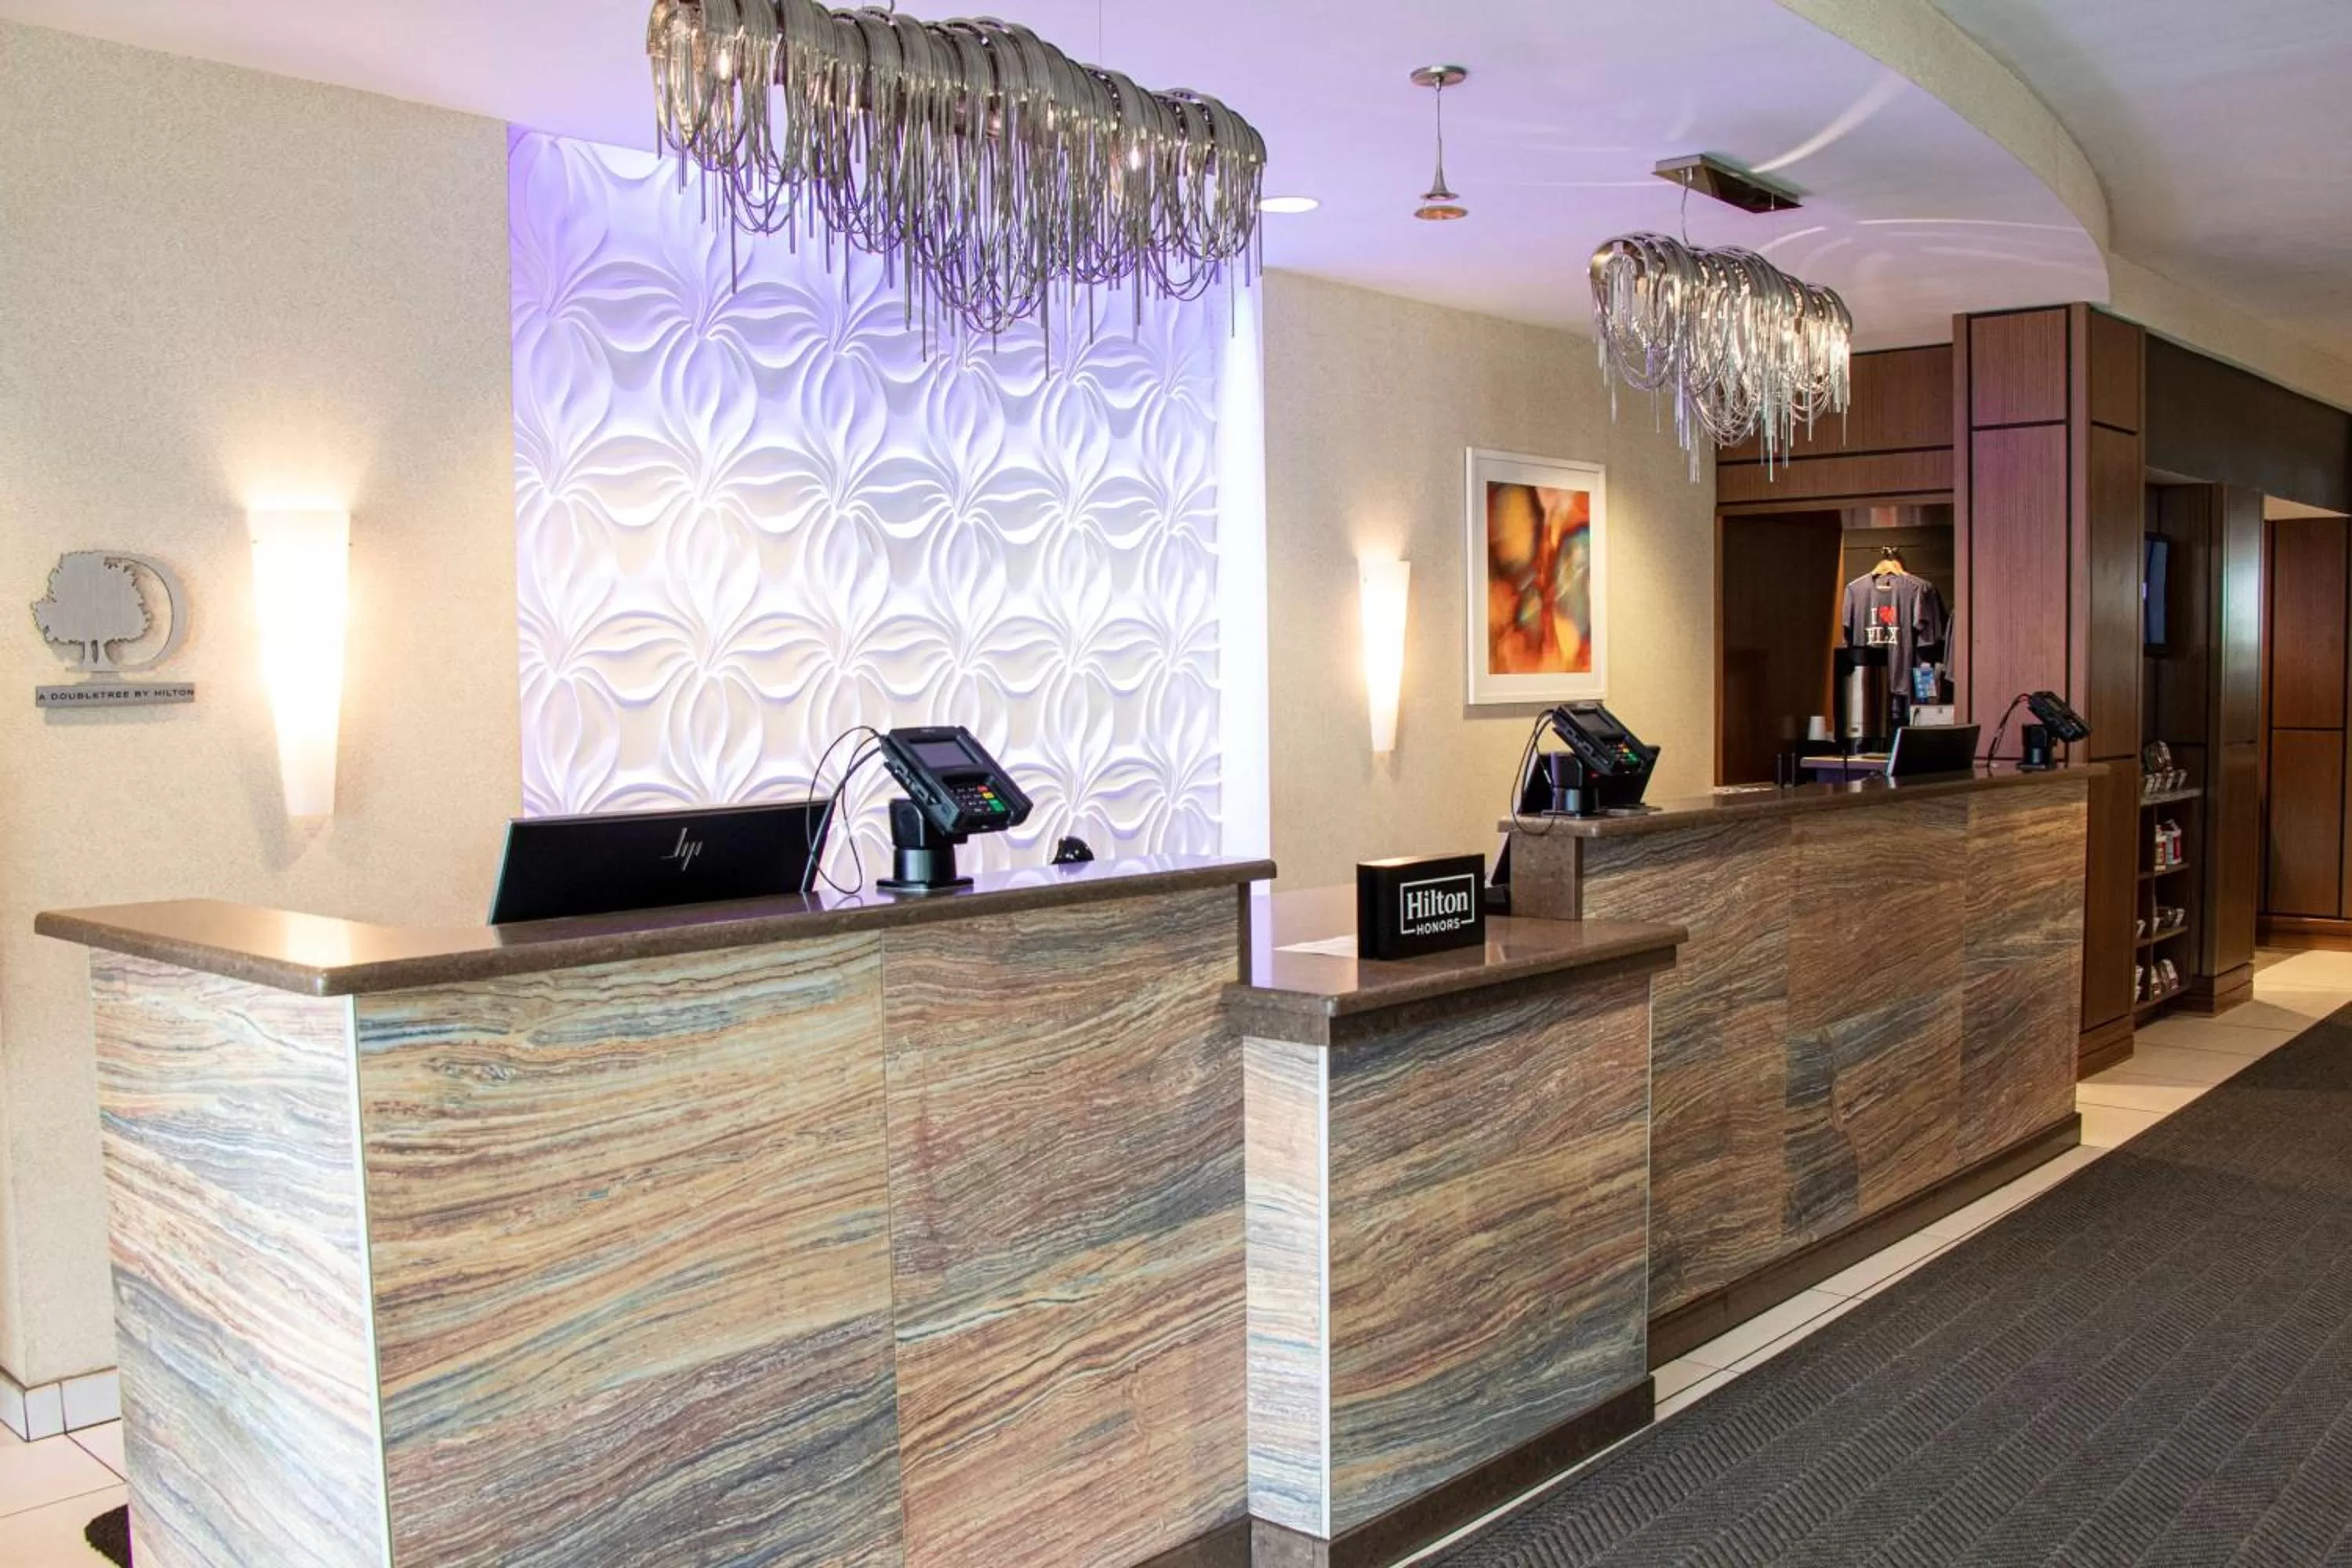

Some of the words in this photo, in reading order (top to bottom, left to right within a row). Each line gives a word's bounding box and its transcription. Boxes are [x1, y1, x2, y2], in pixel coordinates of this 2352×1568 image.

[1871, 608, 1878, 625] I
[51, 691, 129, 700] DOUBLETREE
[134, 690, 147, 699] BY
[1406, 889, 1468, 920] Hilton
[1417, 918, 1461, 935] HONORS
